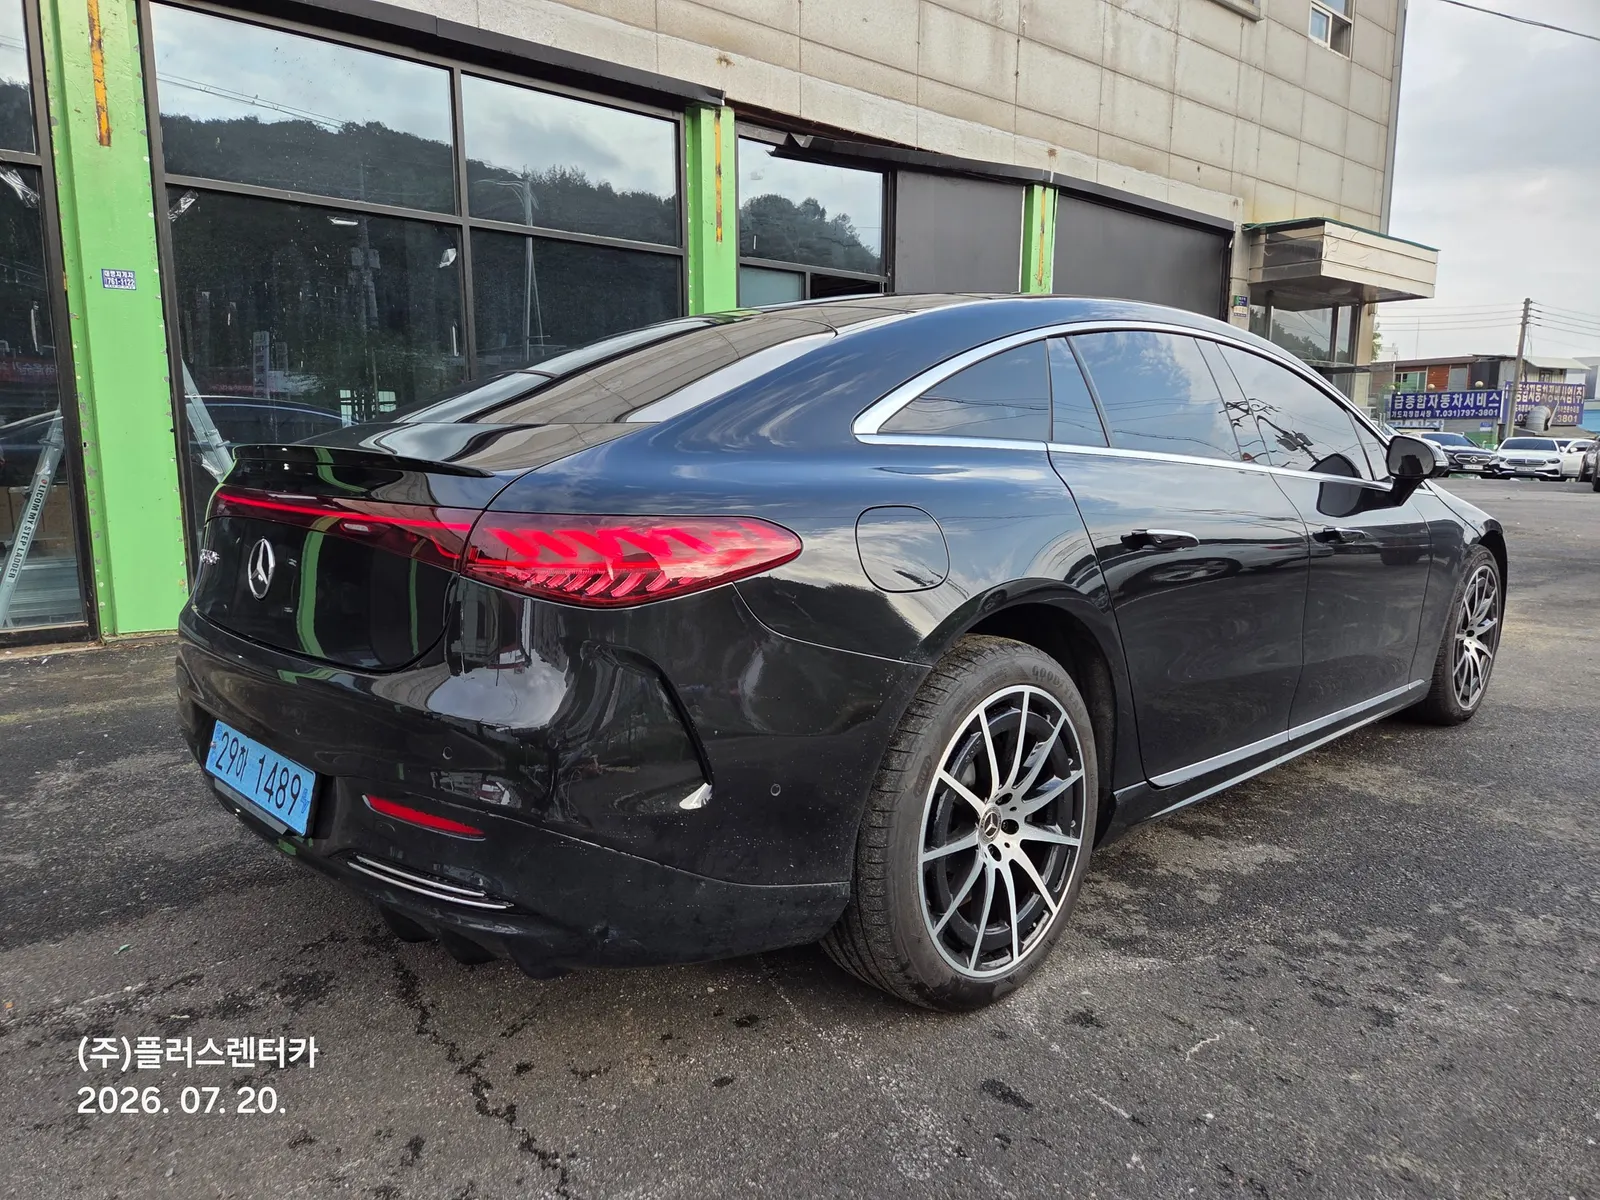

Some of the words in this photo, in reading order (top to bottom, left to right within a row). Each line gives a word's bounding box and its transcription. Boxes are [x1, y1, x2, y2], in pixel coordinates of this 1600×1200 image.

[1435, 408, 1498, 417] T.031)797-3801
[31, 484, 46, 513] LICOM
[27, 512, 37, 525] MY
[20, 525, 32, 547] STEP
[8, 547, 25, 579] LADDER
[215, 731, 249, 782] 29하
[255, 753, 302, 816] 1489
